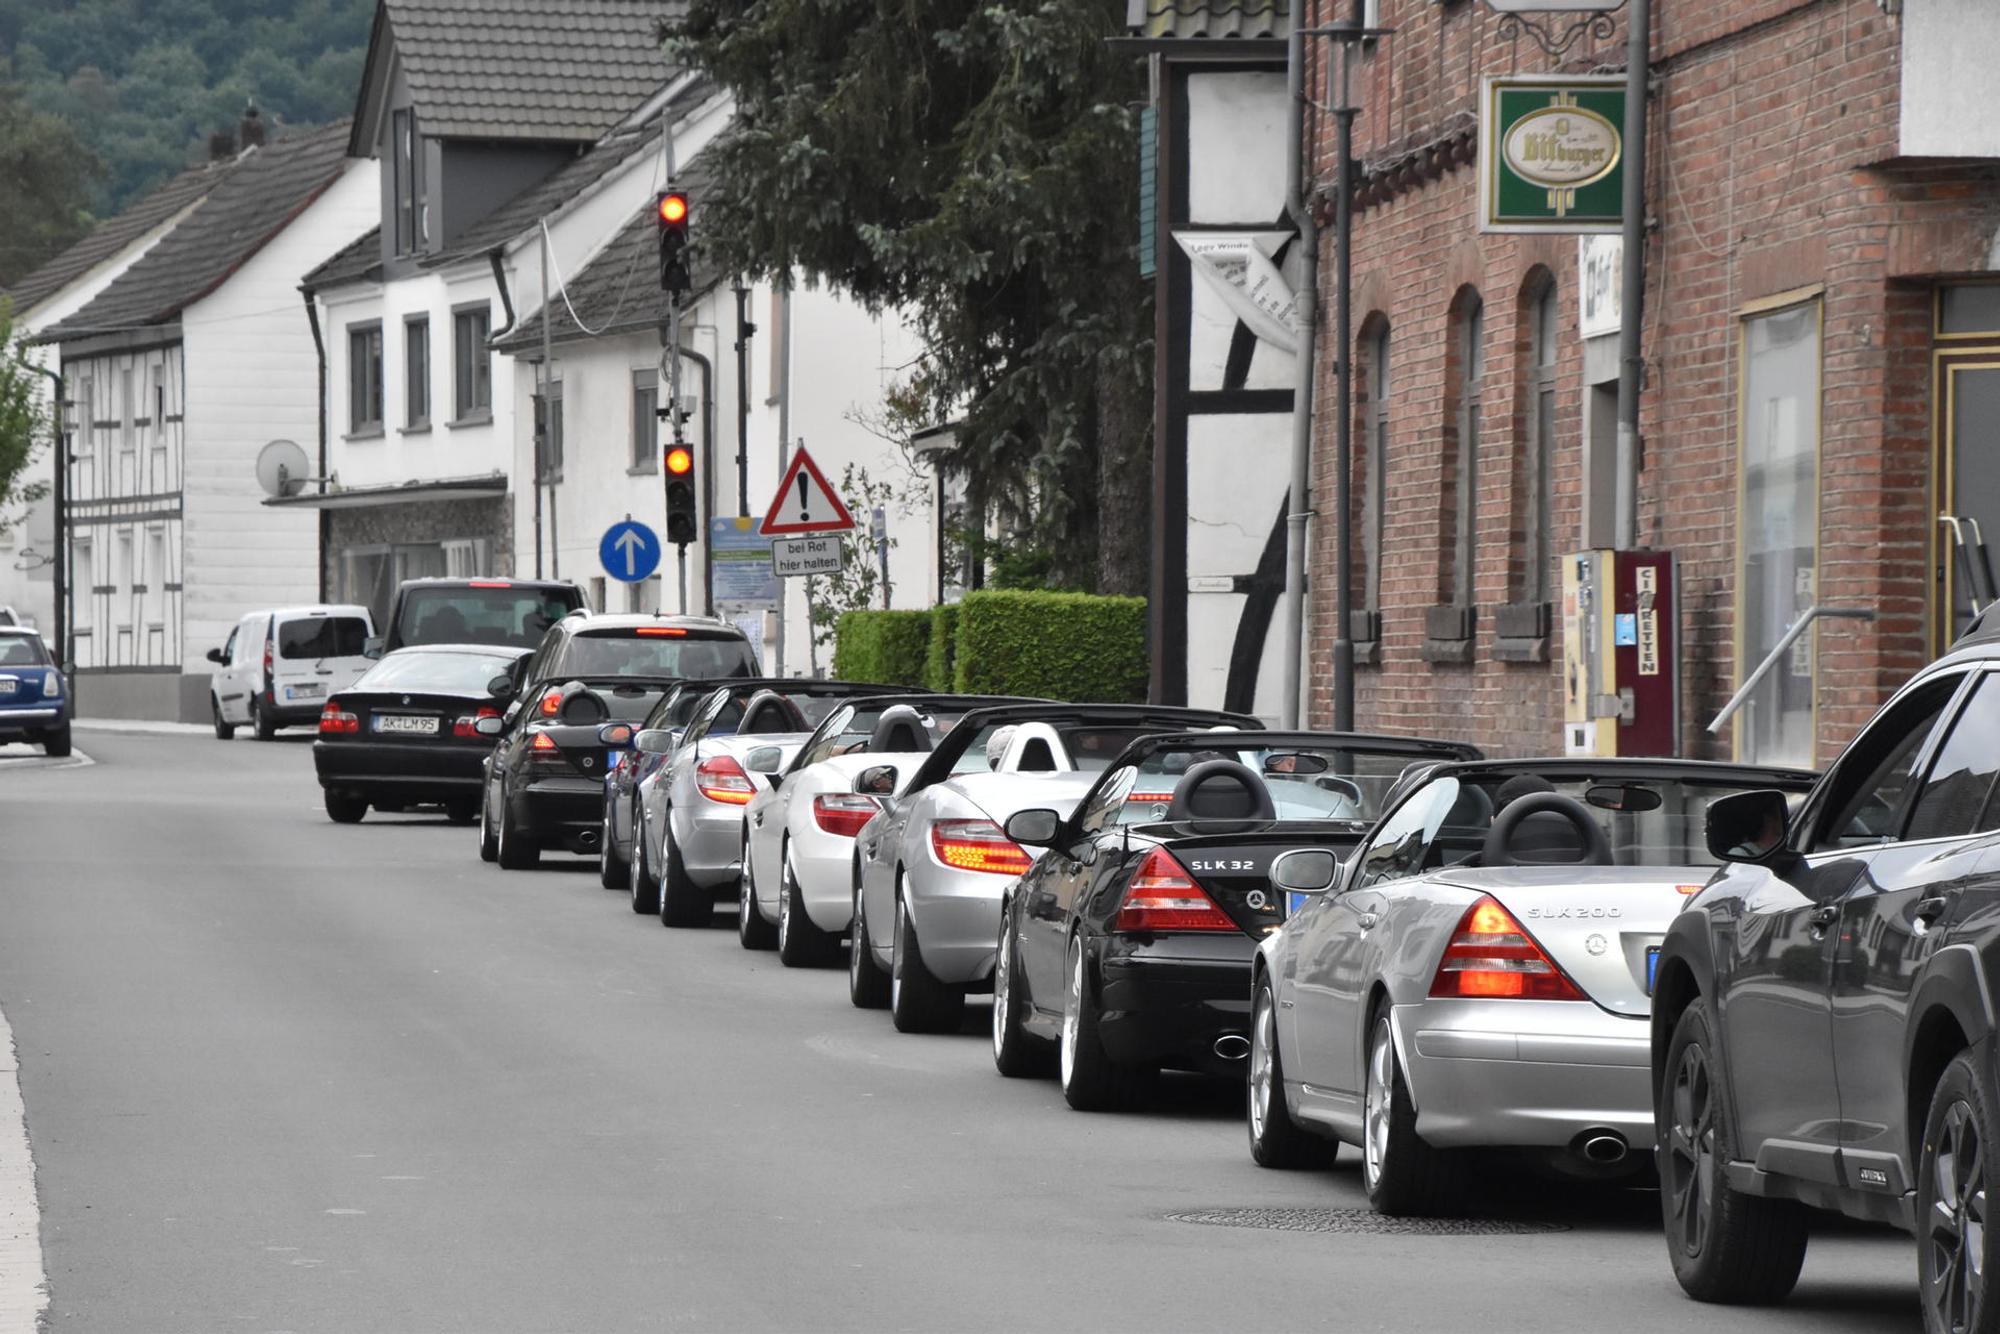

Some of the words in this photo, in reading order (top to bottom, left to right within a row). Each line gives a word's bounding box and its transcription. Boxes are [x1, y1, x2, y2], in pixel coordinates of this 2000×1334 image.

[787, 543, 805, 554] bei
[807, 541, 827, 553] Rot
[780, 559, 801, 571] hier
[803, 557, 838, 569] halten
[1641, 569, 1655, 672] CIRETTEN
[1191, 861, 1227, 870] SLK
[1230, 861, 1254, 870] 32
[1527, 907, 1571, 918] SLK
[1575, 907, 1622, 918] 200
